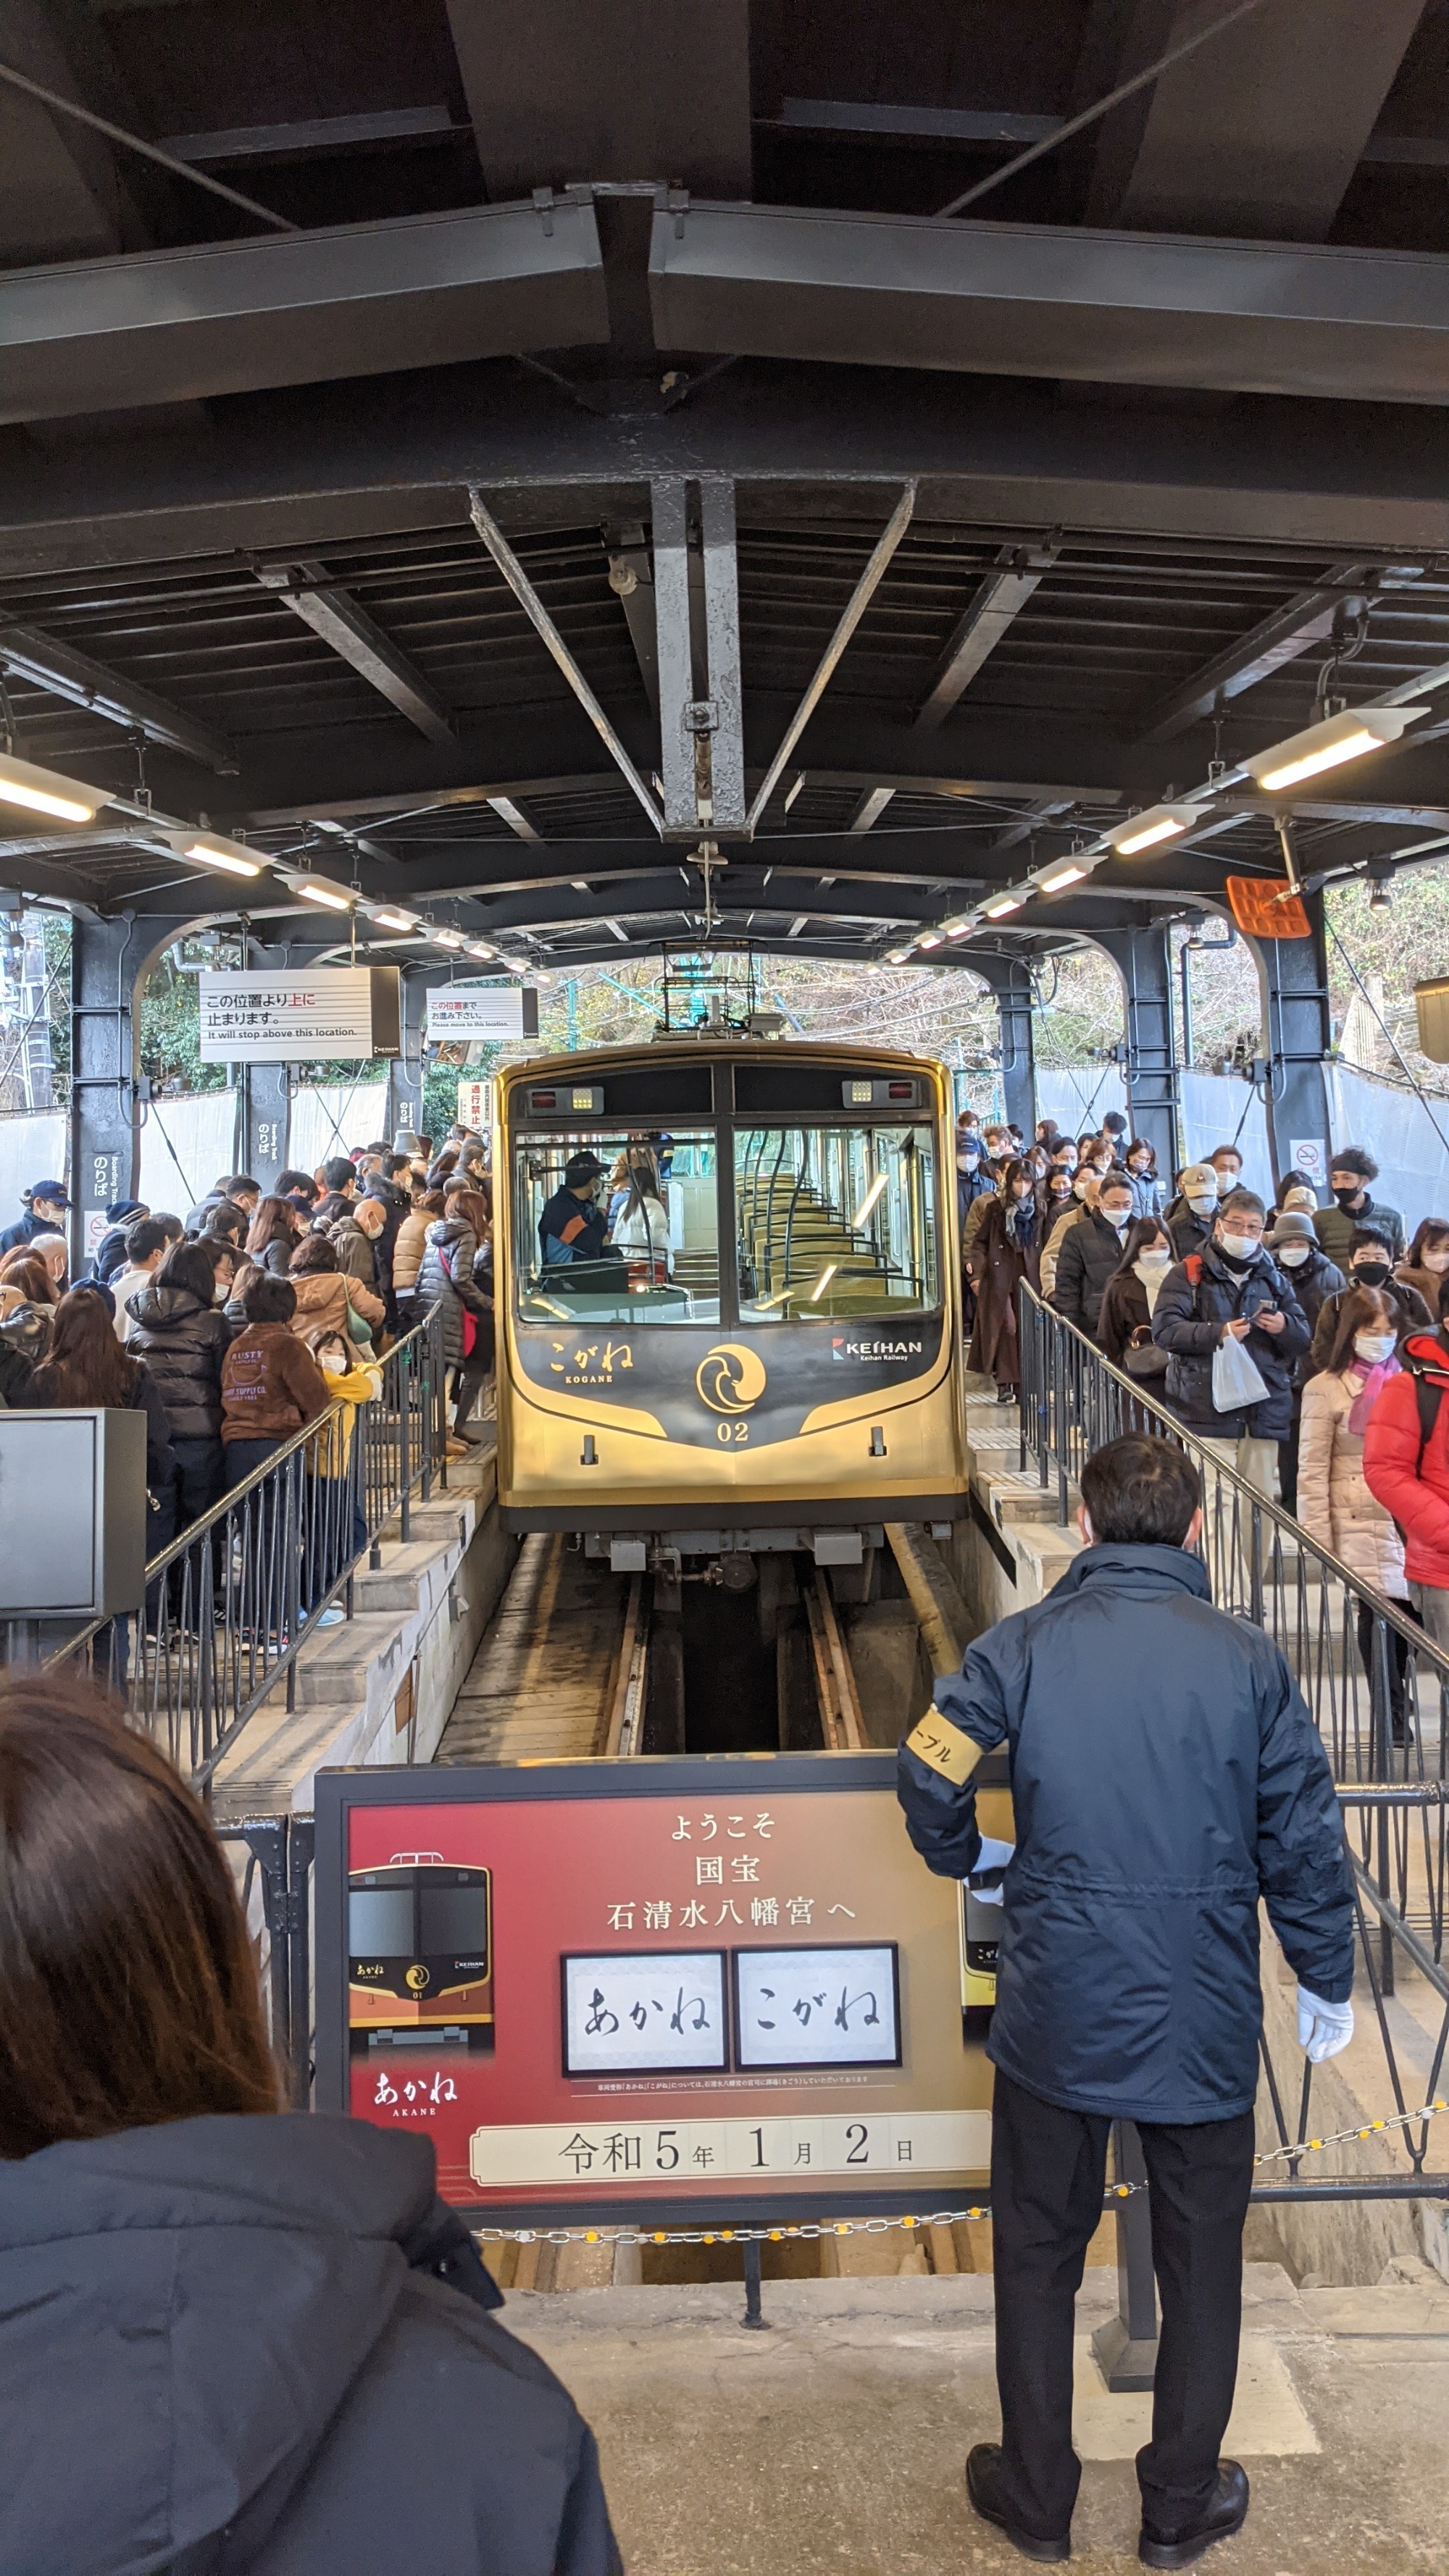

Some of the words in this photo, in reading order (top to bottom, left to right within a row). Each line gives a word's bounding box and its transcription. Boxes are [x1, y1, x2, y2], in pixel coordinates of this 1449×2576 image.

[207, 992, 316, 1008] この位置より上に
[431, 1001, 477, 1010] この位置まで
[207, 1011, 279, 1026] 止まります。
[432, 1011, 483, 1020] お進み下さい。
[208, 1031, 216, 1040] It
[217, 1030, 235, 1039] will
[238, 1030, 260, 1040] stop
[262, 1029, 293, 1038] above
[295, 1028, 313, 1037] this
[315, 1027, 357, 1037] location.
[399, 1102, 409, 1124] のりば
[471, 1084, 481, 1125] 通行禁止
[258, 1124, 270, 1154] のりば
[93, 1156, 109, 1197] のりば
[110, 1156, 119, 1187] Boarding
[231, 1350, 264, 1360] RUSTY
[551, 1342, 634, 1372] こがね
[846, 1341, 922, 1354] KEIHAN
[565, 1375, 613, 1384] KOGANE
[717, 1422, 748, 1442] 02
[671, 1812, 775, 1841] ようこそ
[696, 1854, 761, 1886] 国宝
[356, 1964, 385, 1975] あかね
[585, 1986, 711, 2037] あかね
[757, 1986, 880, 2032] こがね
[374, 2071, 458, 2105] あかね
[392, 2107, 436, 2117] AKANE
